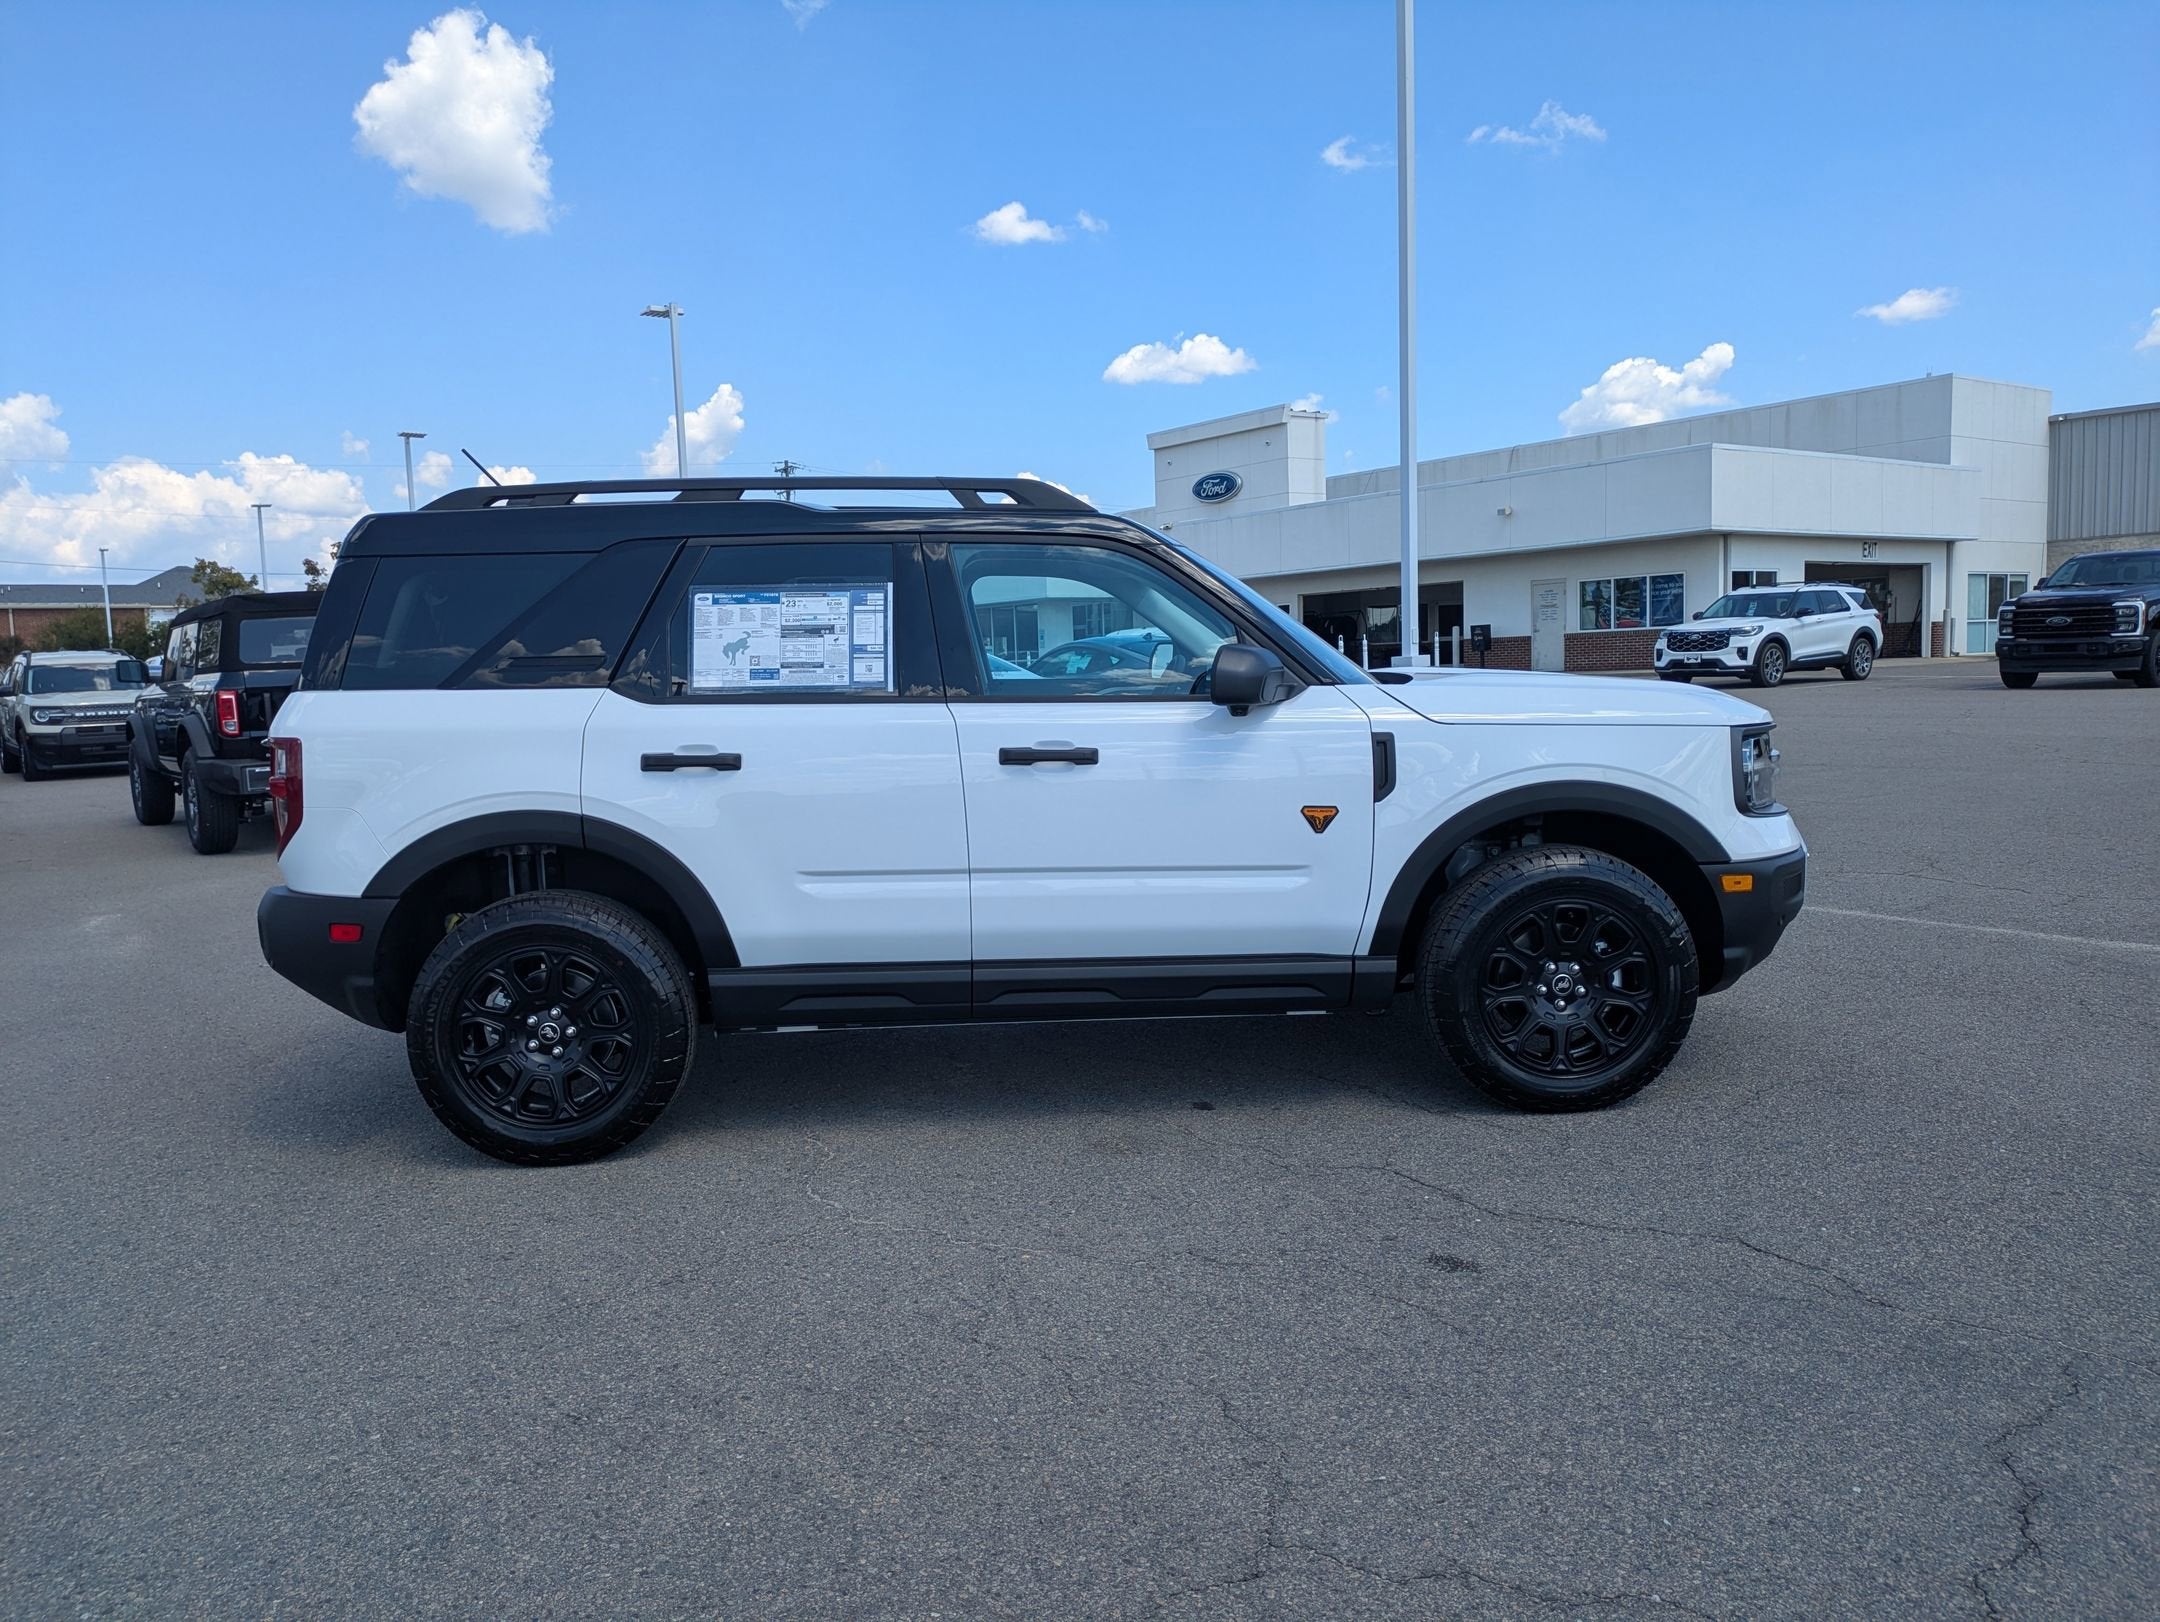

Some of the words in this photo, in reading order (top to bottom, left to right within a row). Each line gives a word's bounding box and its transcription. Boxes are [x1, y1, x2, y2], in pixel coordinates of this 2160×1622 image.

[1201, 478, 1227, 497] Ford
[1863, 541, 1878, 558] EXIT
[785, 599, 797, 608] 23
